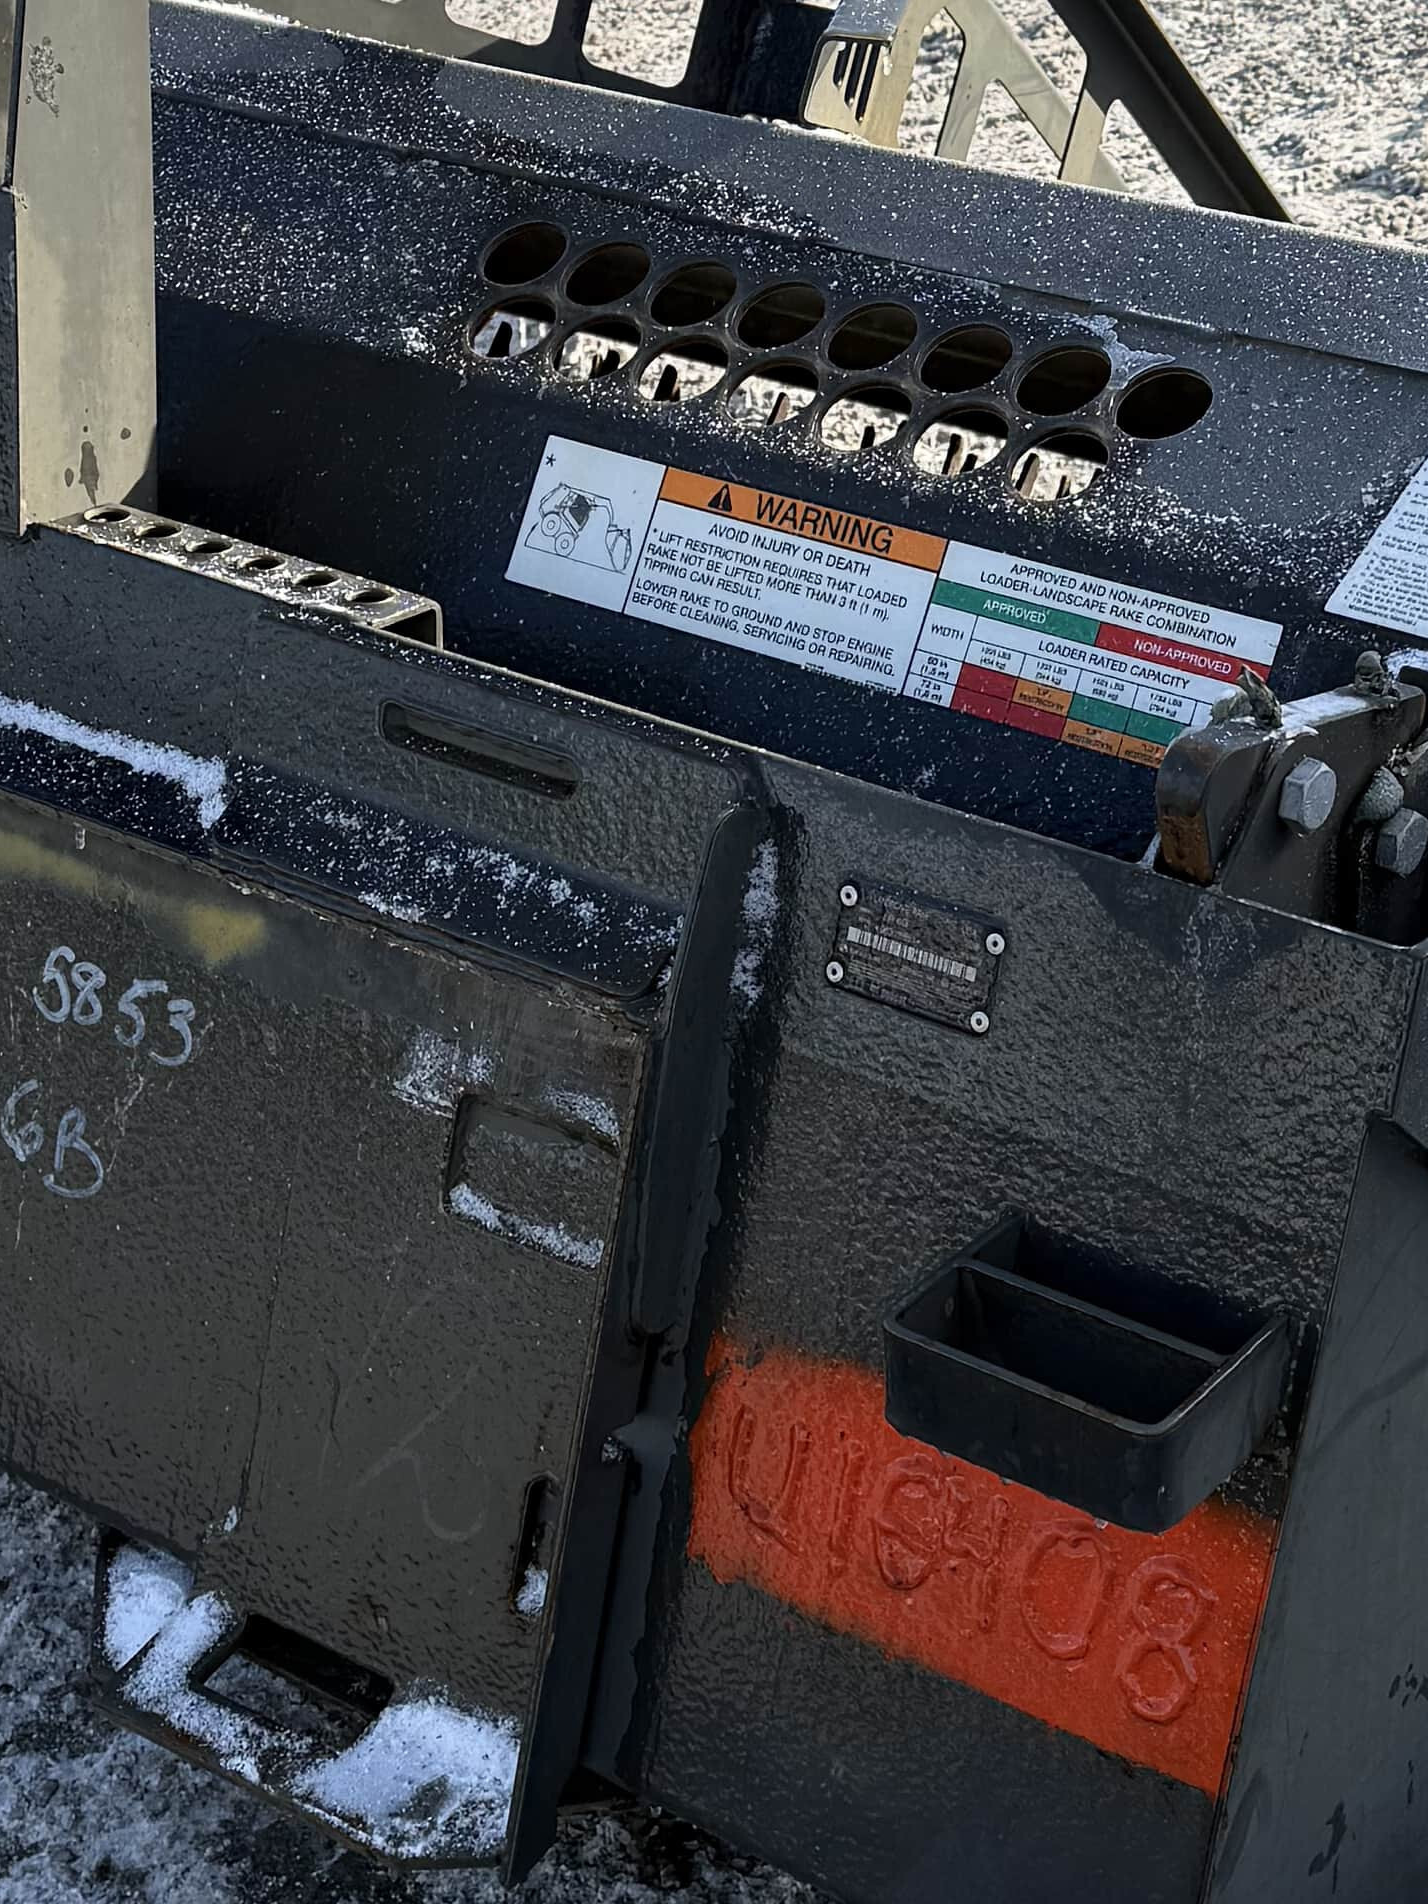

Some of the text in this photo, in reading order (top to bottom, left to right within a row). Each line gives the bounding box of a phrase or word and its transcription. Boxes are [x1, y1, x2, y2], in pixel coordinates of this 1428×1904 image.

[708, 522, 871, 577] AVOID INJURY OR DEATH
[756, 495, 894, 554] WARNING
[642, 557, 763, 600] TIPPING CAN RESULT.
[646, 543, 678, 562] RAKE
[679, 552, 704, 569] NOT
[705, 559, 722, 574] BE
[723, 564, 764, 586] LIFTED
[765, 575, 801, 596] MORE
[805, 586, 836, 606] THAN
[837, 595, 847, 609] 3
[847, 598, 858, 612] ft
[859, 601, 869, 615] (1
[657, 530, 907, 609] LIFT RESTRICTION REQUIRES THAT LOADED
[1009, 562, 1210, 624] APPROVED AND NON-APPROVED
[630, 592, 677, 615] BEFORE
[678, 605, 741, 633] CLEANING,
[741, 623, 805, 652] SERVICING
[807, 641, 826, 658] OR
[827, 647, 897, 678] REPAIRING.
[635, 577, 893, 660] LOWER RAKE TO GROUND AND STOP ENGINE
[930, 623, 964, 641] WIDTH
[979, 571, 1237, 648] LOADER-LANDSCAPE RAKE COMBINATION
[982, 598, 1046, 625] APPROVED
[1037, 640, 1189, 690] LOADER RATED CAPACITY
[1133, 639, 1231, 675] NON-APPROVED
[32, 944, 198, 1068] 5853
[0, 1078, 106, 1199] 6B
